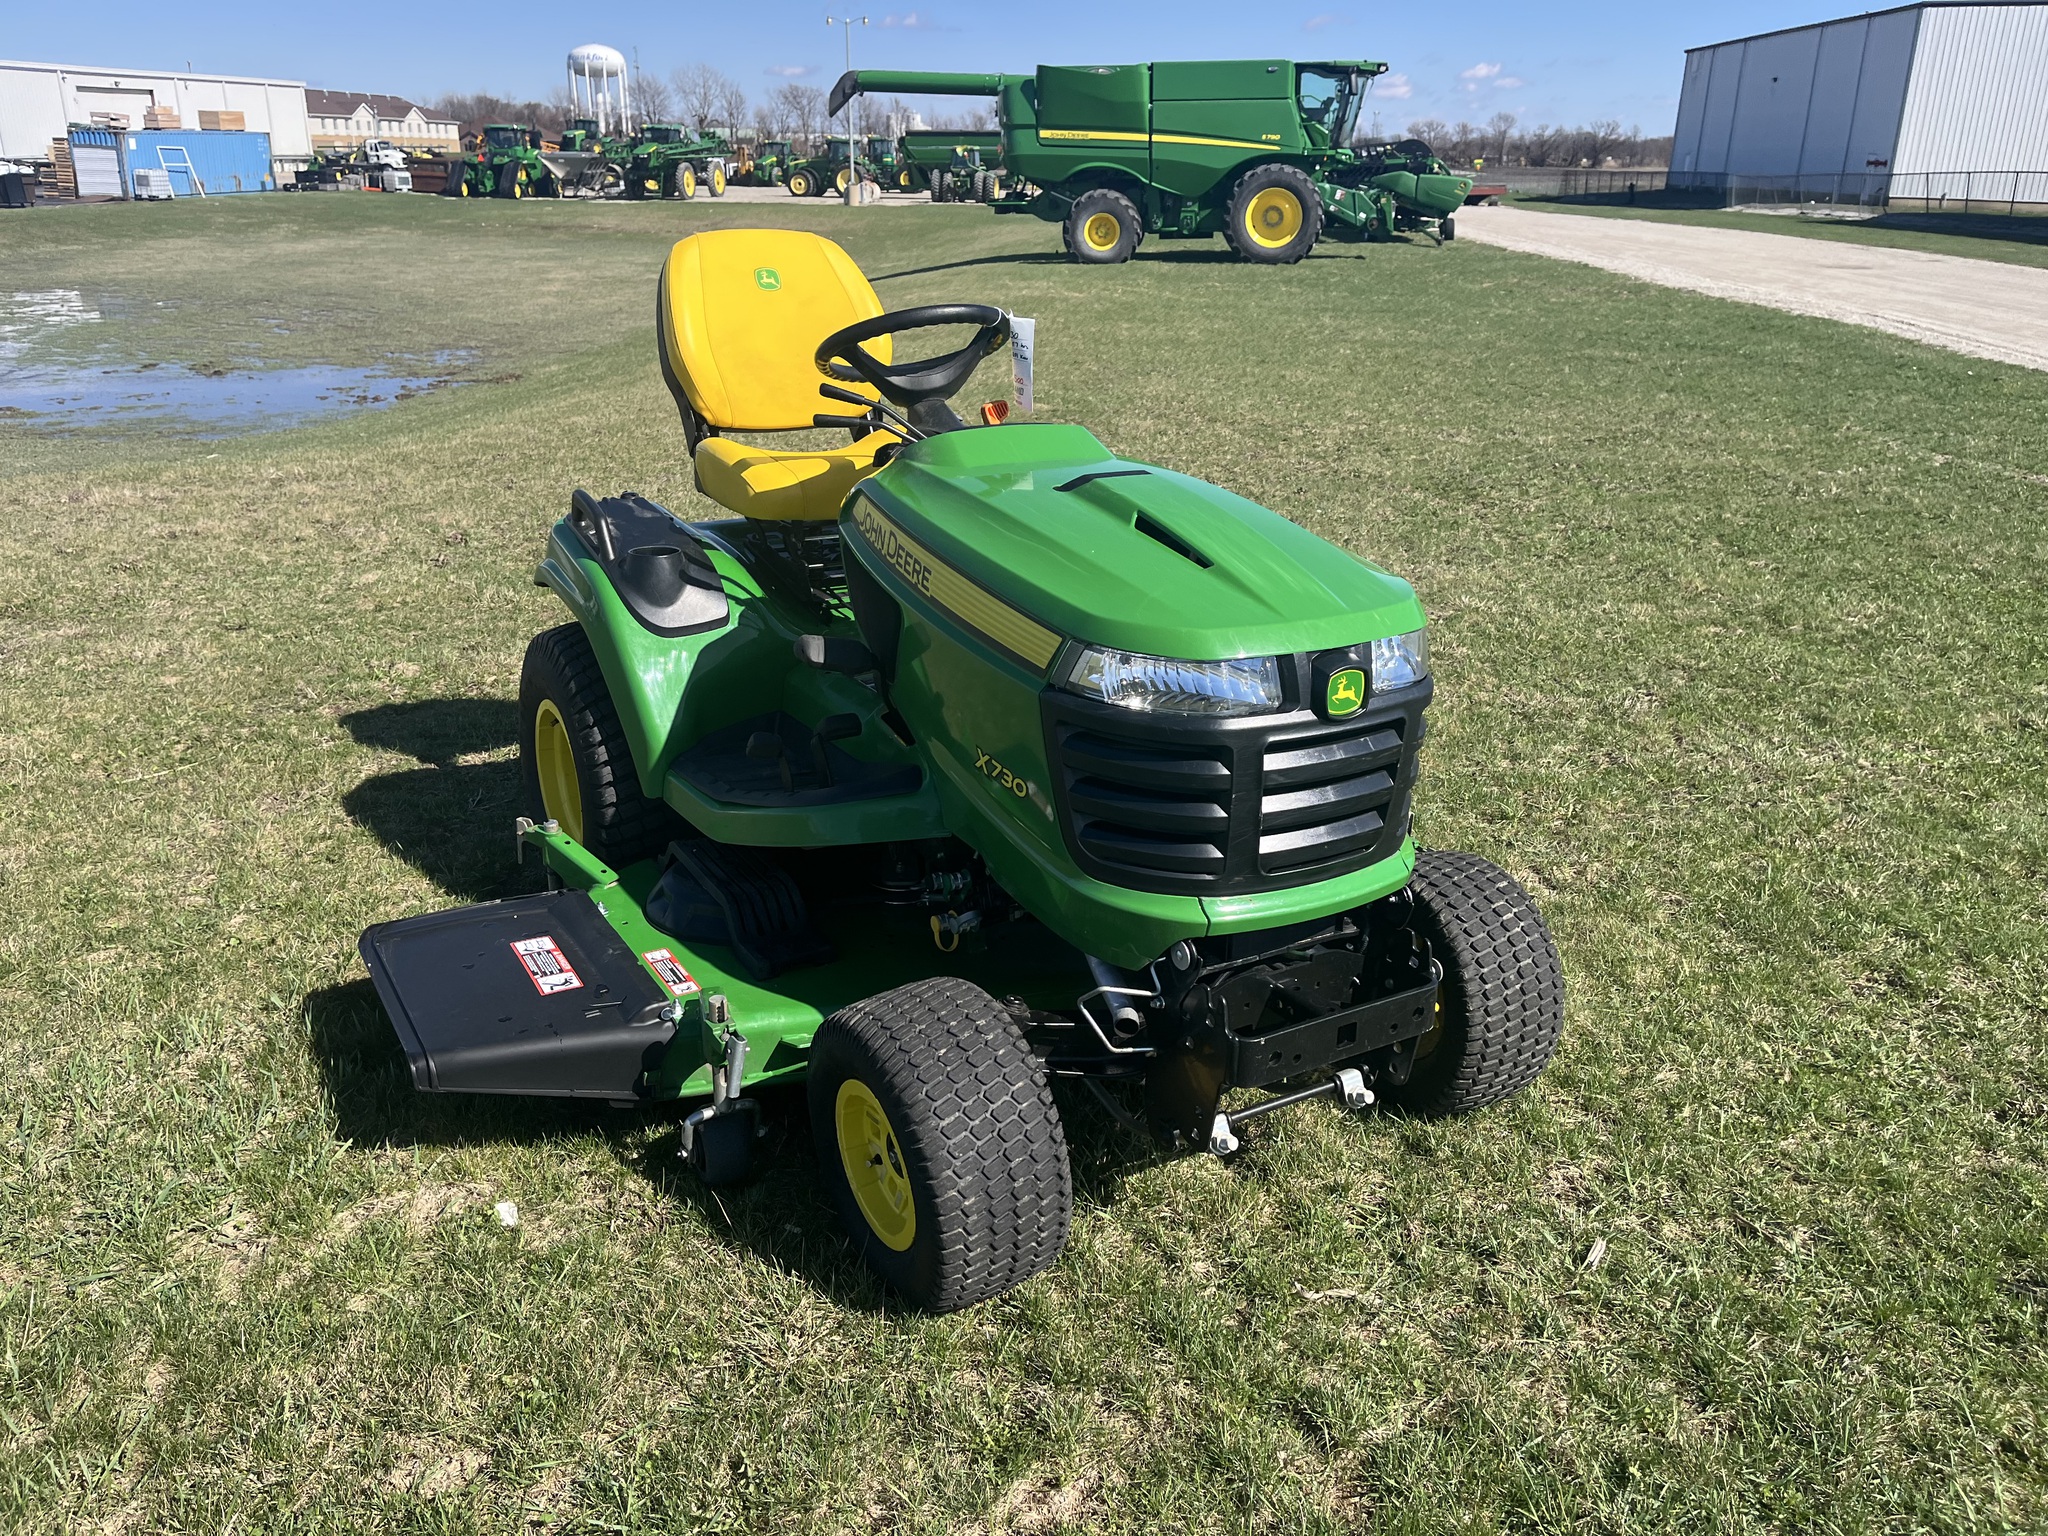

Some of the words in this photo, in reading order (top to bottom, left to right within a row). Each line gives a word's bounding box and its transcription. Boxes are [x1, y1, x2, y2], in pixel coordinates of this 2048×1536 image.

[858, 503, 886, 553] JOHN
[886, 530, 933, 592] DEERE
[974, 746, 1027, 798] X730
